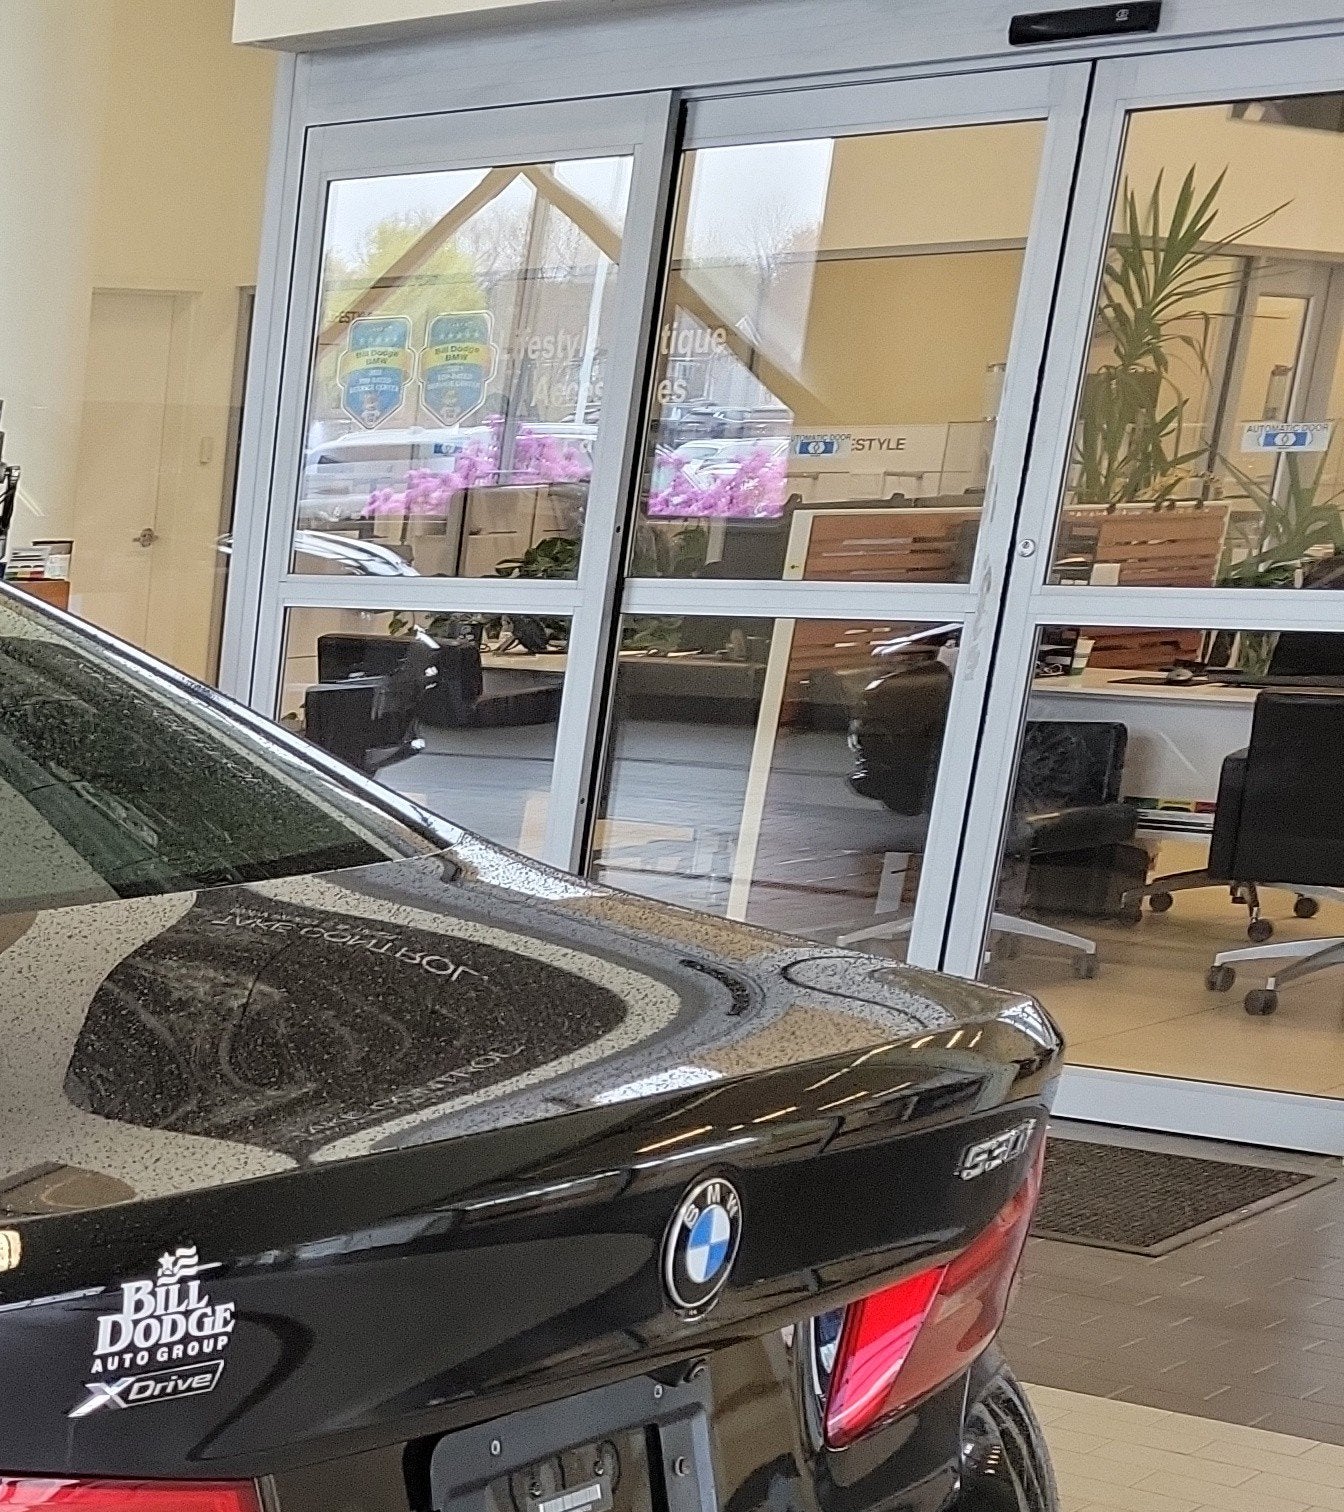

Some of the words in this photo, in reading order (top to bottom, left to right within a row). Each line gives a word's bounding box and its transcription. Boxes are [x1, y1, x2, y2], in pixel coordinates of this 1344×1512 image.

[370, 350, 399, 358] Dodge
[435, 347, 449, 355] Bill
[450, 345, 480, 354] Dodge
[1247, 424, 1297, 433] AUTOMATIC
[1300, 423, 1328, 431] DOOR
[683, 1183, 739, 1230] BMW
[120, 1279, 209, 1320] BILL
[92, 1301, 236, 1356] DODGE
[90, 1352, 149, 1374] AUTO
[156, 1335, 229, 1363] GROUP
